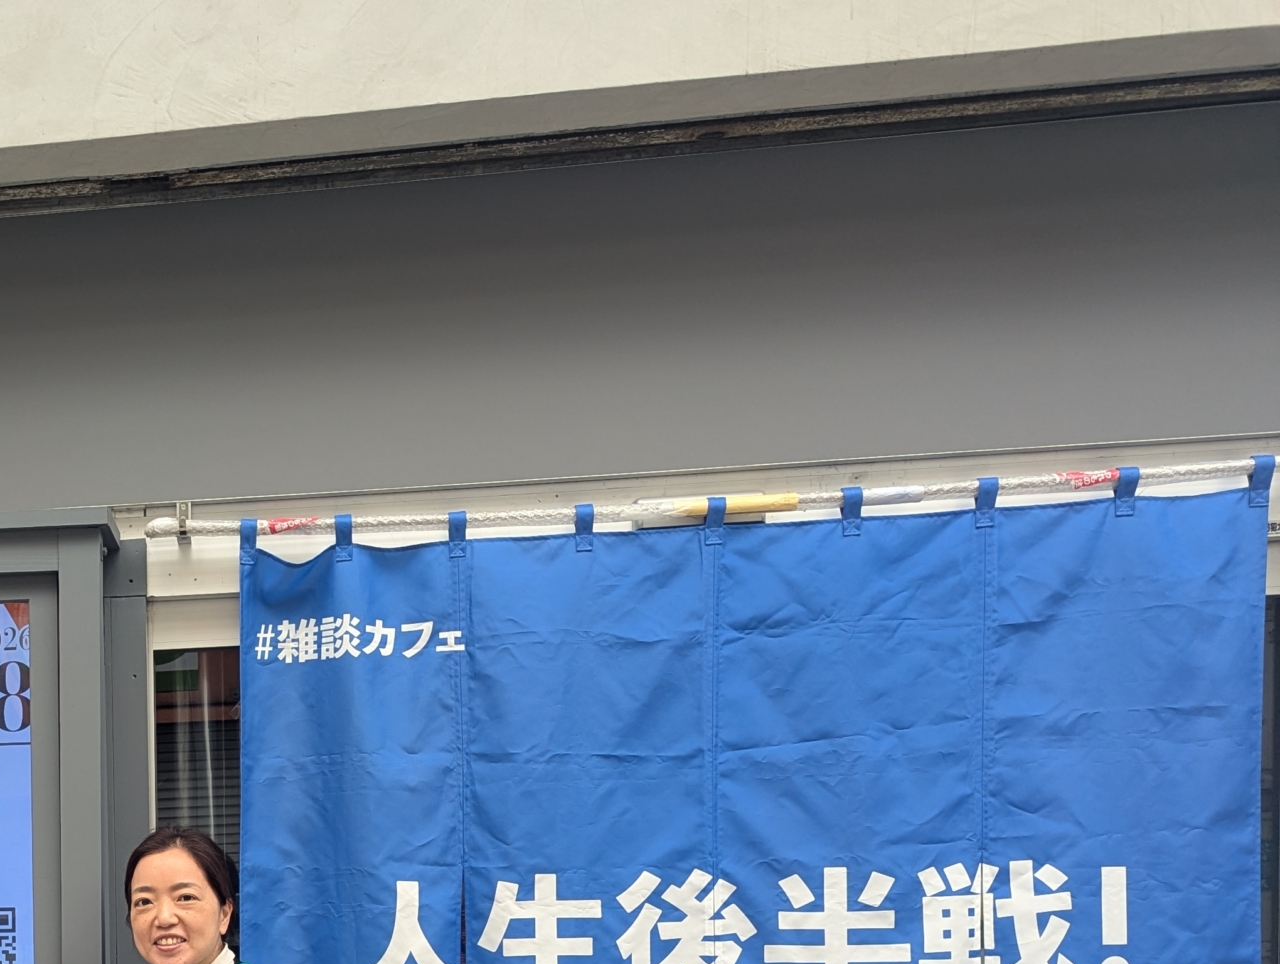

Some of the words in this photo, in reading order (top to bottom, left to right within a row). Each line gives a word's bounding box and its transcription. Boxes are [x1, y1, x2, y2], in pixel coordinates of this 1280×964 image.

[254, 613, 466, 664] #雑談カフェ
